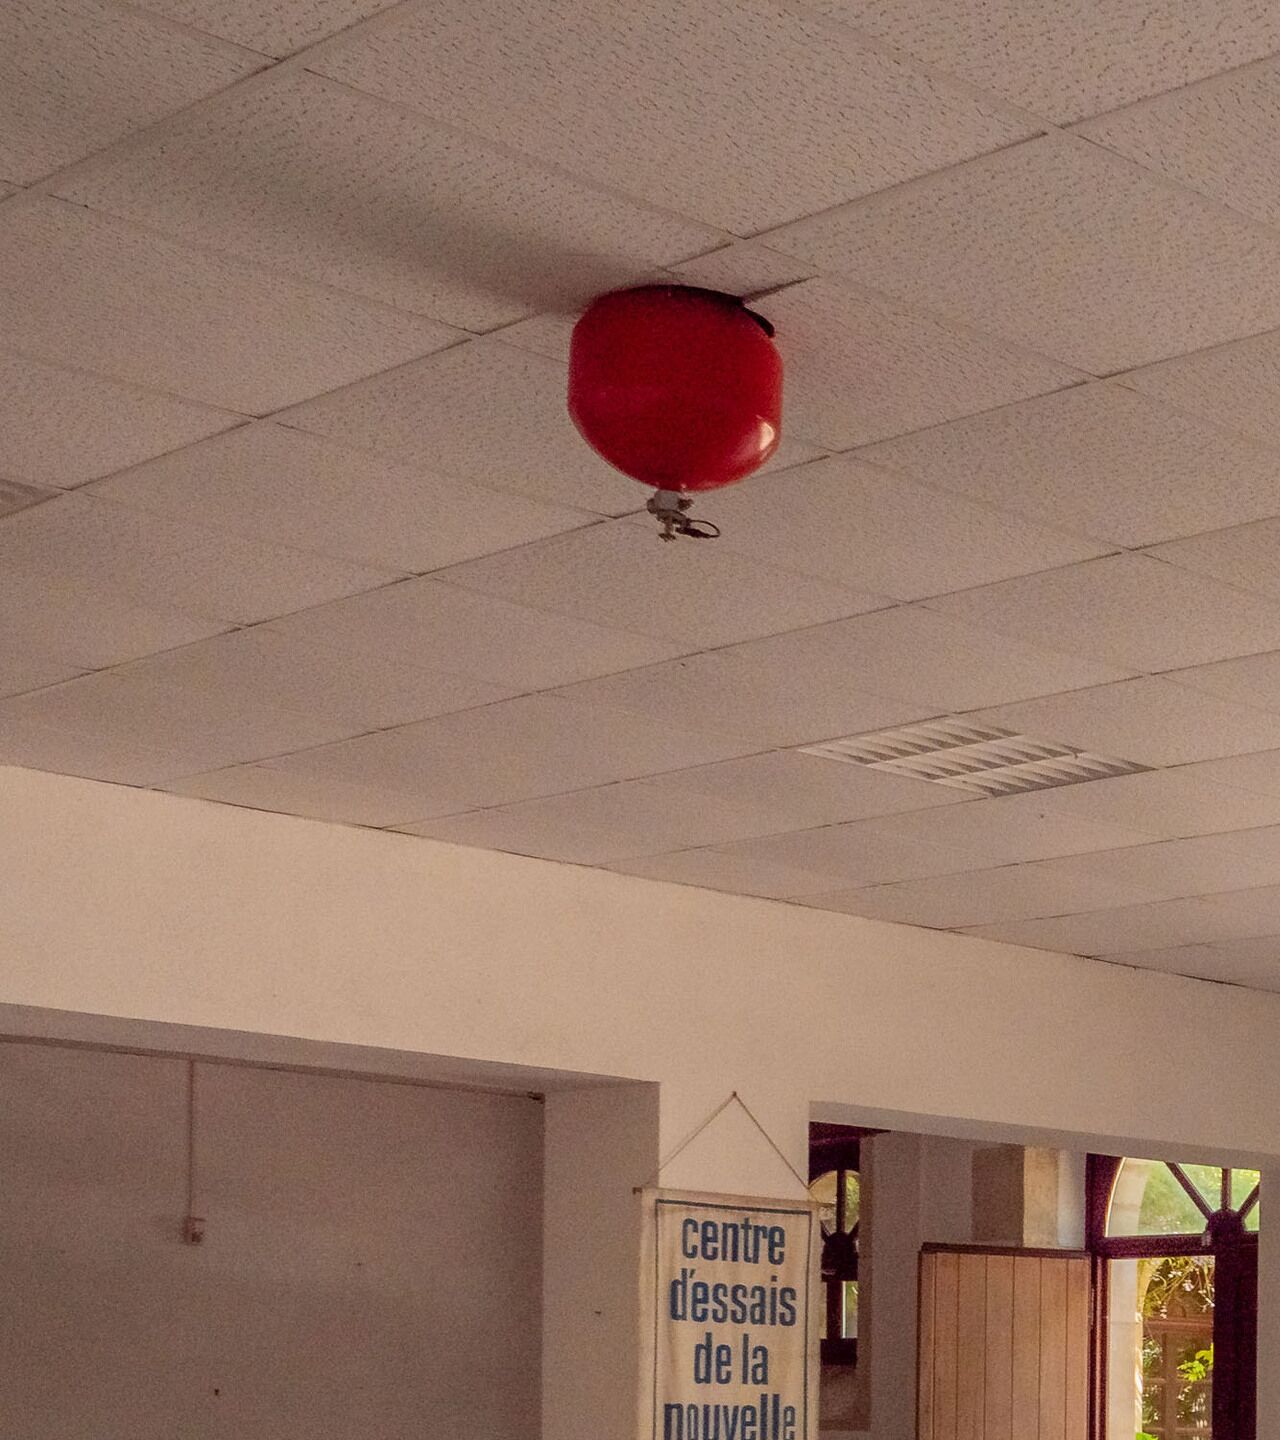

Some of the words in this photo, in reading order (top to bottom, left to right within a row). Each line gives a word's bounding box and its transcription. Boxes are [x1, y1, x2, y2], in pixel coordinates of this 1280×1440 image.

[682, 1216, 786, 1265] centre
[670, 1267, 797, 1327] d'essais
[694, 1331, 733, 1385] de
[742, 1333, 769, 1386] la
